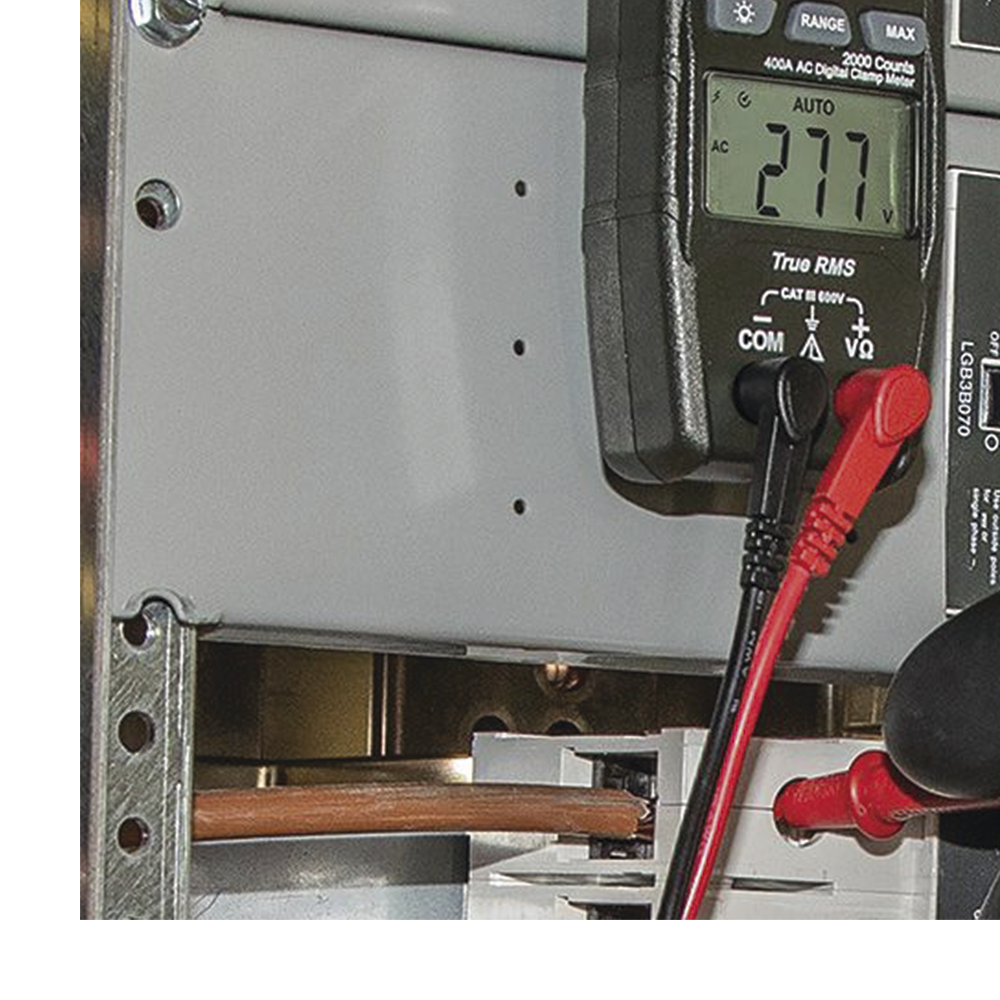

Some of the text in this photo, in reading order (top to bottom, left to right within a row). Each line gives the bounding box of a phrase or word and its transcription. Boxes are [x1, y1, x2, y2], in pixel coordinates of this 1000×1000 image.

[801, 14, 846, 33] RANGE
[886, 25, 916, 42] MAX
[763, 57, 916, 88] 400A AC Digital Clamp Meter
[841, 52, 916, 76] 2000 Counts
[792, 95, 835, 117] AUTO
[711, 140, 730, 154] AC
[756, 122, 869, 222] 277
[882, 208, 894, 225] V
[771, 252, 856, 277] True RMS
[781, 287, 804, 301] CAT
[818, 291, 846, 305] 600V
[738, 328, 785, 353] COM
[845, 337, 875, 360] VΩ
[989, 330, 1000, 357] OFF
[957, 340, 975, 437] LGB3B070
